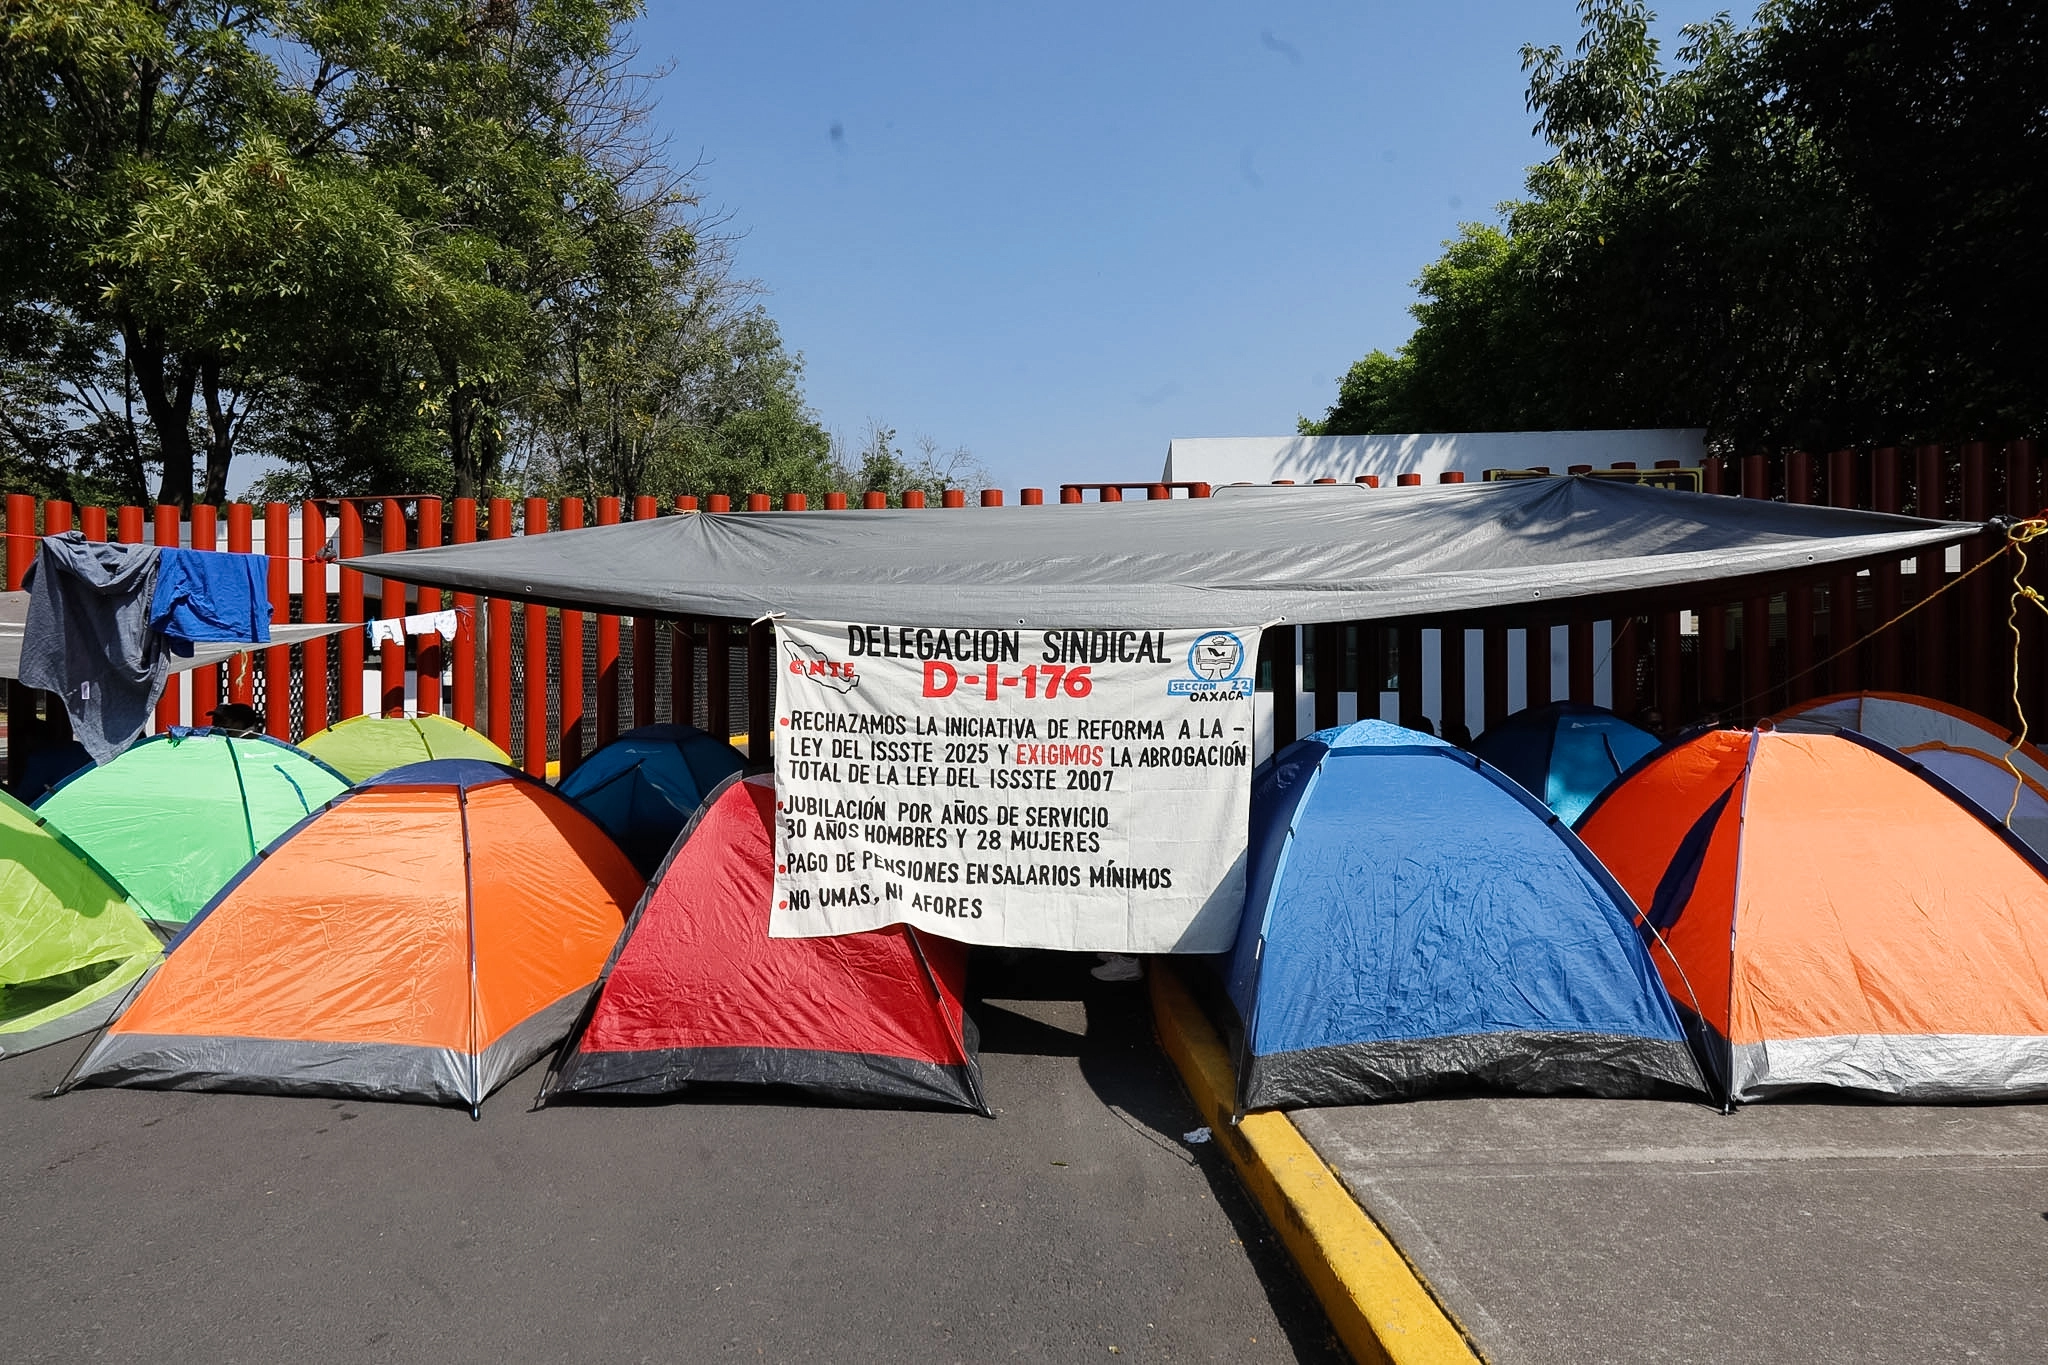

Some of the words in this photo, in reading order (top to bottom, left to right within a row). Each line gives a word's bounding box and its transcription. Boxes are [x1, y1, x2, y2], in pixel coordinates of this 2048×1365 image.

[848, 625, 1019, 662] DELEGACION
[1042, 631, 1171, 664] SINDICAL
[789, 660, 855, 677] CNTE
[1190, 691, 1243, 702] OAXACA
[1232, 681, 1249, 690] 22
[790, 710, 906, 735] RECHAZAMOS
[916, 716, 938, 736] LA
[946, 717, 1037, 739] INICIATIVA
[1048, 719, 1068, 739] DE
[1078, 719, 1164, 740] REFORMA
[1178, 719, 1191, 739] A
[1200, 718, 1223, 739] LA
[790, 737, 822, 757] LEY
[832, 739, 863, 759] DEL
[871, 741, 933, 763] ISSSTE
[945, 743, 988, 763] 2025
[998, 744, 1009, 764] Y
[1016, 744, 1103, 766] EXIGIMOS
[1111, 747, 1132, 767] LA
[1139, 741, 1246, 767] ABROGACIÓN
[789, 760, 841, 783] TOTAL
[850, 764, 870, 784] DE
[877, 765, 899, 785] LA
[907, 767, 939, 786] LEY
[947, 767, 979, 788] DEL
[991, 769, 1056, 790] ISSSTE
[1067, 770, 1113, 791] 2007
[783, 795, 885, 821] JUBILACIÓN
[899, 802, 932, 823] POR
[941, 800, 988, 826] AÑOS
[997, 806, 1019, 826] DE
[1026, 807, 1108, 828] SERVICIO
[786, 819, 806, 839] 30
[814, 820, 859, 841] AÑOS
[865, 824, 947, 848] HOMBRES
[956, 829, 967, 848] Y
[977, 830, 1001, 850] 28
[1011, 830, 1100, 853] MUJERES
[788, 852, 827, 874] PAGO
[836, 852, 855, 873] DE
[863, 851, 959, 884] PENSIONES
[1090, 859, 1172, 890] MÍNIMOS
[789, 889, 810, 911] NO
[819, 884, 880, 907] UMAS,
[886, 882, 903, 900] NI
[912, 892, 982, 919] AFORES
